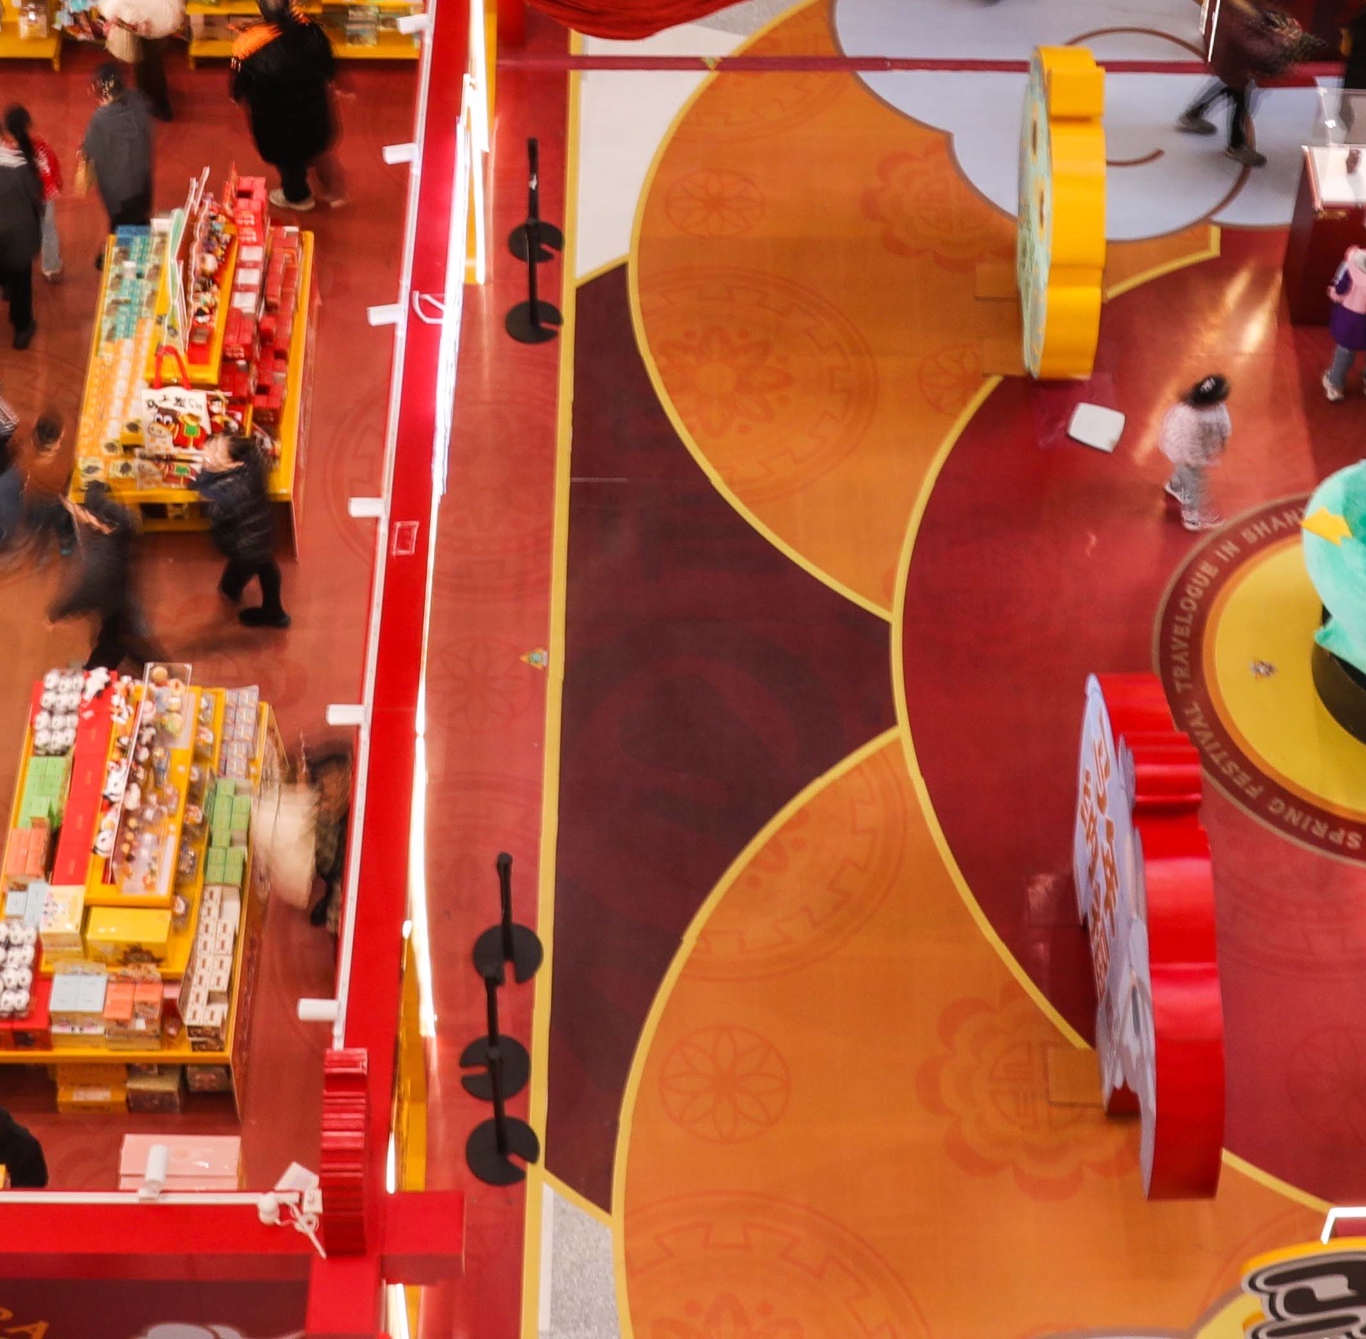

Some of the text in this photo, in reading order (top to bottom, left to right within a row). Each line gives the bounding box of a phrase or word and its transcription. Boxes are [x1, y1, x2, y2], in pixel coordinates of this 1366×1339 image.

[1214, 541, 1241, 563] IN
[1241, 507, 1304, 545] SHAN
[1175, 561, 1220, 695] TRAVELOGUE
[1181, 698, 1264, 816] FESTIVAL
[1267, 797, 1365, 851] SPRING
